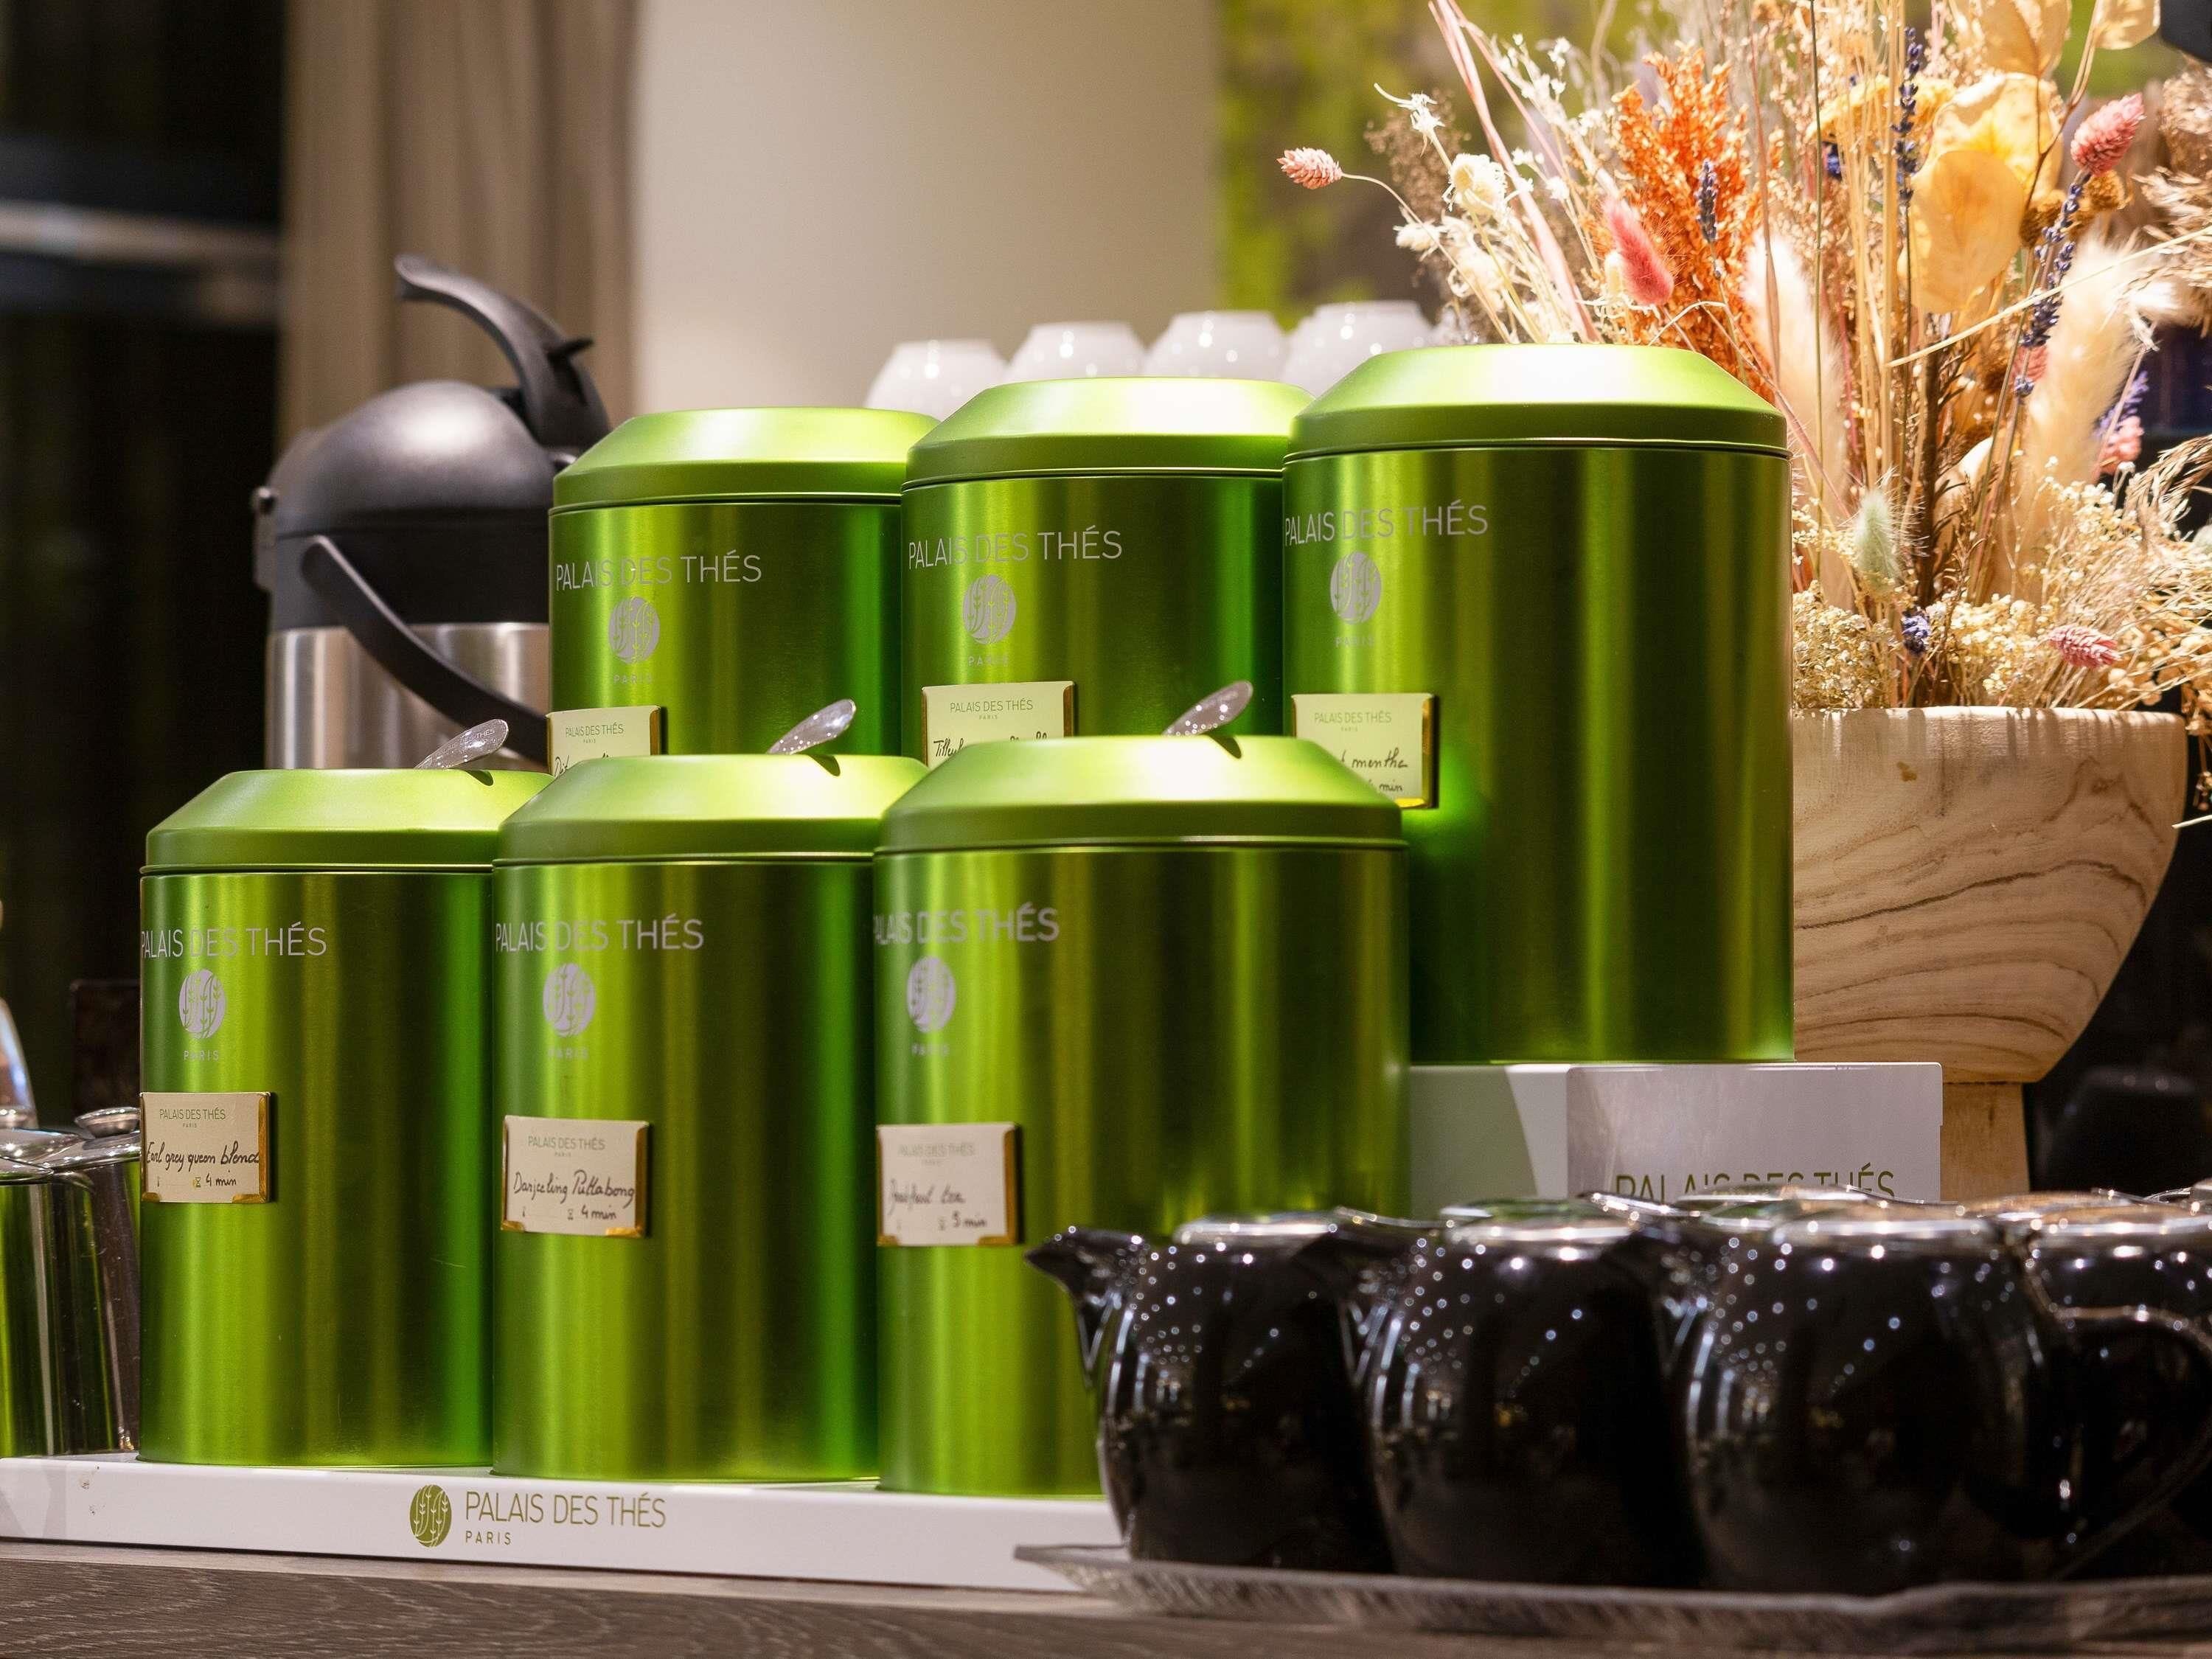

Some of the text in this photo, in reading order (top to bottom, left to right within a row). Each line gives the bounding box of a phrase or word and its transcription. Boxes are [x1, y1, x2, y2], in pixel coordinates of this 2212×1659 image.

[1284, 499, 1489, 547] PALAIS DES THÉS
[908, 525, 1123, 570] PALAIS DES THÉS
[556, 549, 762, 591] PALAIS DES THÉS
[950, 698, 1033, 713] PALAIS DES THÉS
[1315, 710, 1391, 724] PALAIS DES THÉS
[585, 725, 599, 736] DES
[602, 722, 625, 734] THÉS
[975, 901, 1060, 943] THÉS
[189, 928, 238, 957] DES
[245, 921, 327, 956] THÉS
[495, 913, 704, 952] PALAIS DES THÉS
[159, 1107, 226, 1120] PALAIS DES THÉS
[557, 1137, 576, 1150] DES
[578, 1137, 605, 1151] THÉS
[206, 1173, 212, 1186] 4
[581, 1205, 588, 1219] 4
[466, 1491, 667, 1528] PALAIS DES THÉS
[465, 1531, 512, 1545] PARIS
